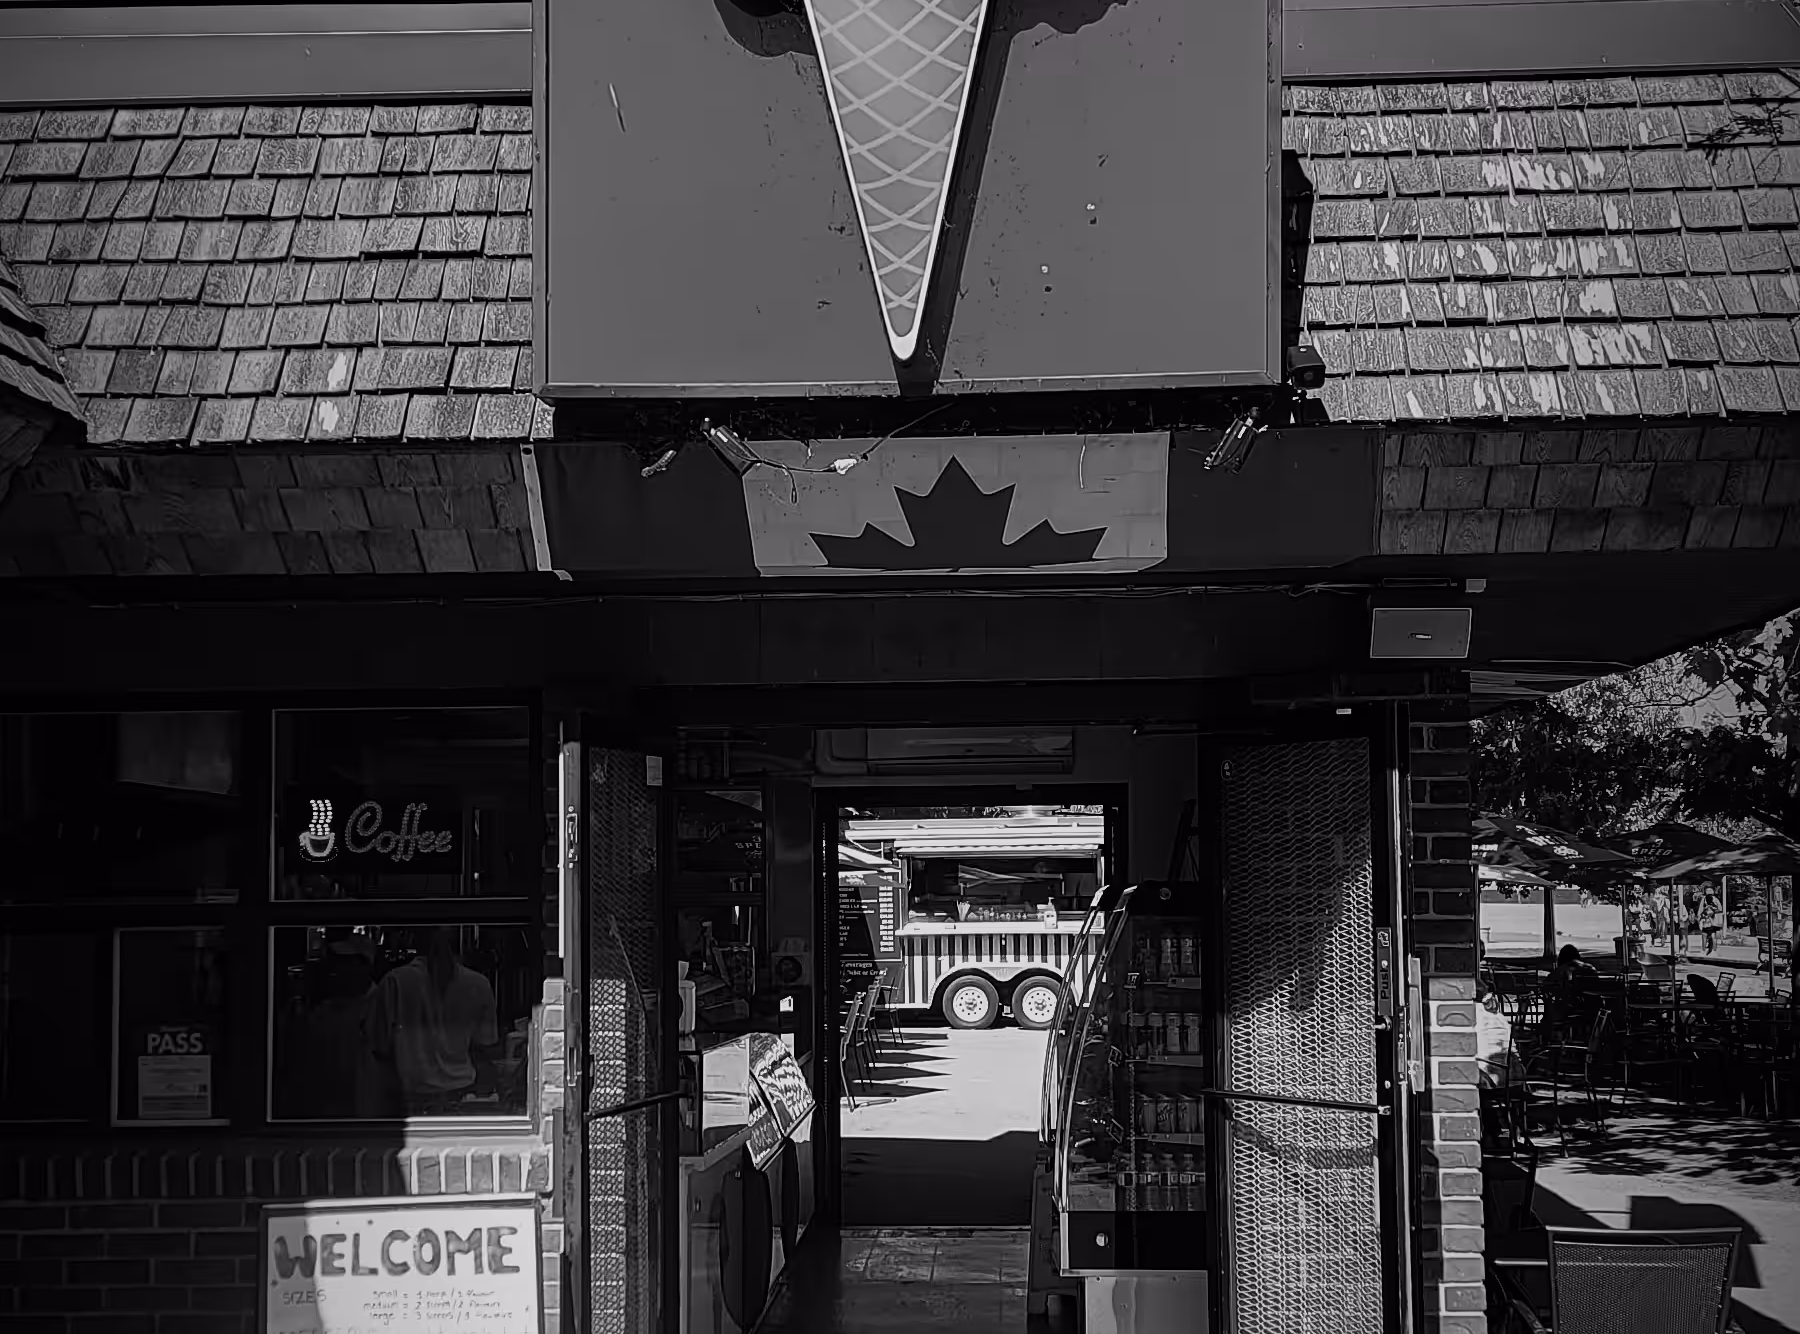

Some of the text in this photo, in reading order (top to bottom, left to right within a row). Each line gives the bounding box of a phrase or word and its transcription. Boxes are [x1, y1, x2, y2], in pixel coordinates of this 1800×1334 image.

[345, 800, 452, 862] Coffee
[146, 1031, 205, 1055] PASS
[273, 1226, 521, 1280] WELCOME
[282, 1289, 327, 1306] SIZES
